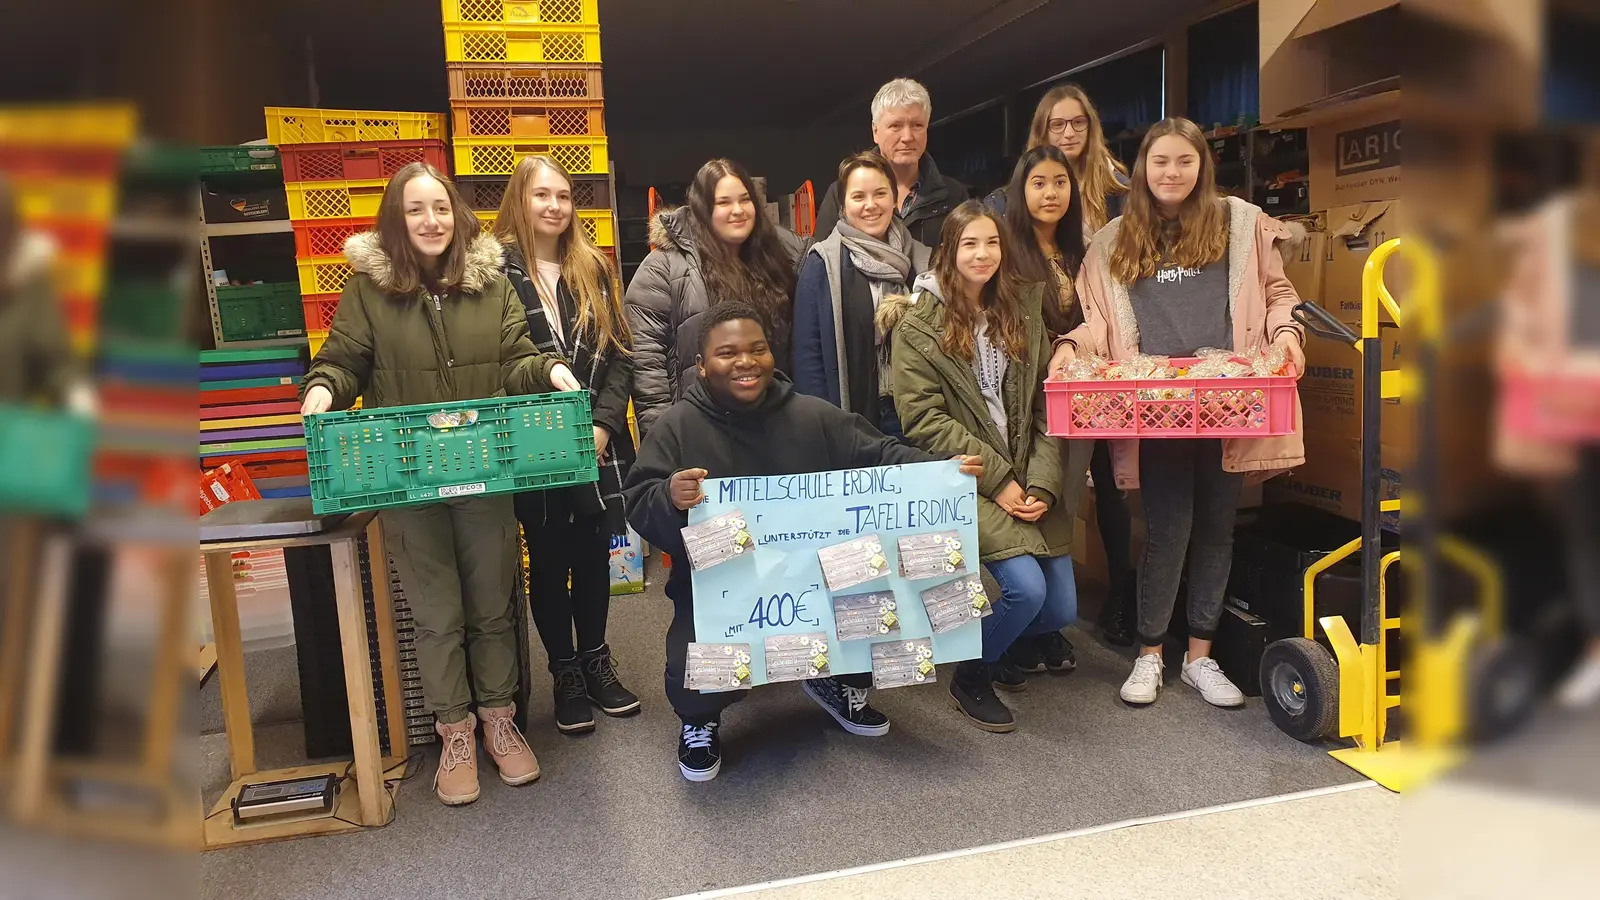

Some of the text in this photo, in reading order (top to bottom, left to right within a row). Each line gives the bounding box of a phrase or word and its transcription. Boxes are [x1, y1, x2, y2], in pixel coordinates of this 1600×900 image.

[1156, 266, 1204, 285] Harry Potter
[1340, 300, 1363, 311] Faltkis
[719, 472, 834, 503] MITTELSCHULE
[843, 466, 895, 496] ERDING
[764, 496, 966, 543] UNTERSTÜTZT DIE TAFEL ERDING
[728, 623, 744, 634] MIT
[748, 590, 813, 629] 400€
